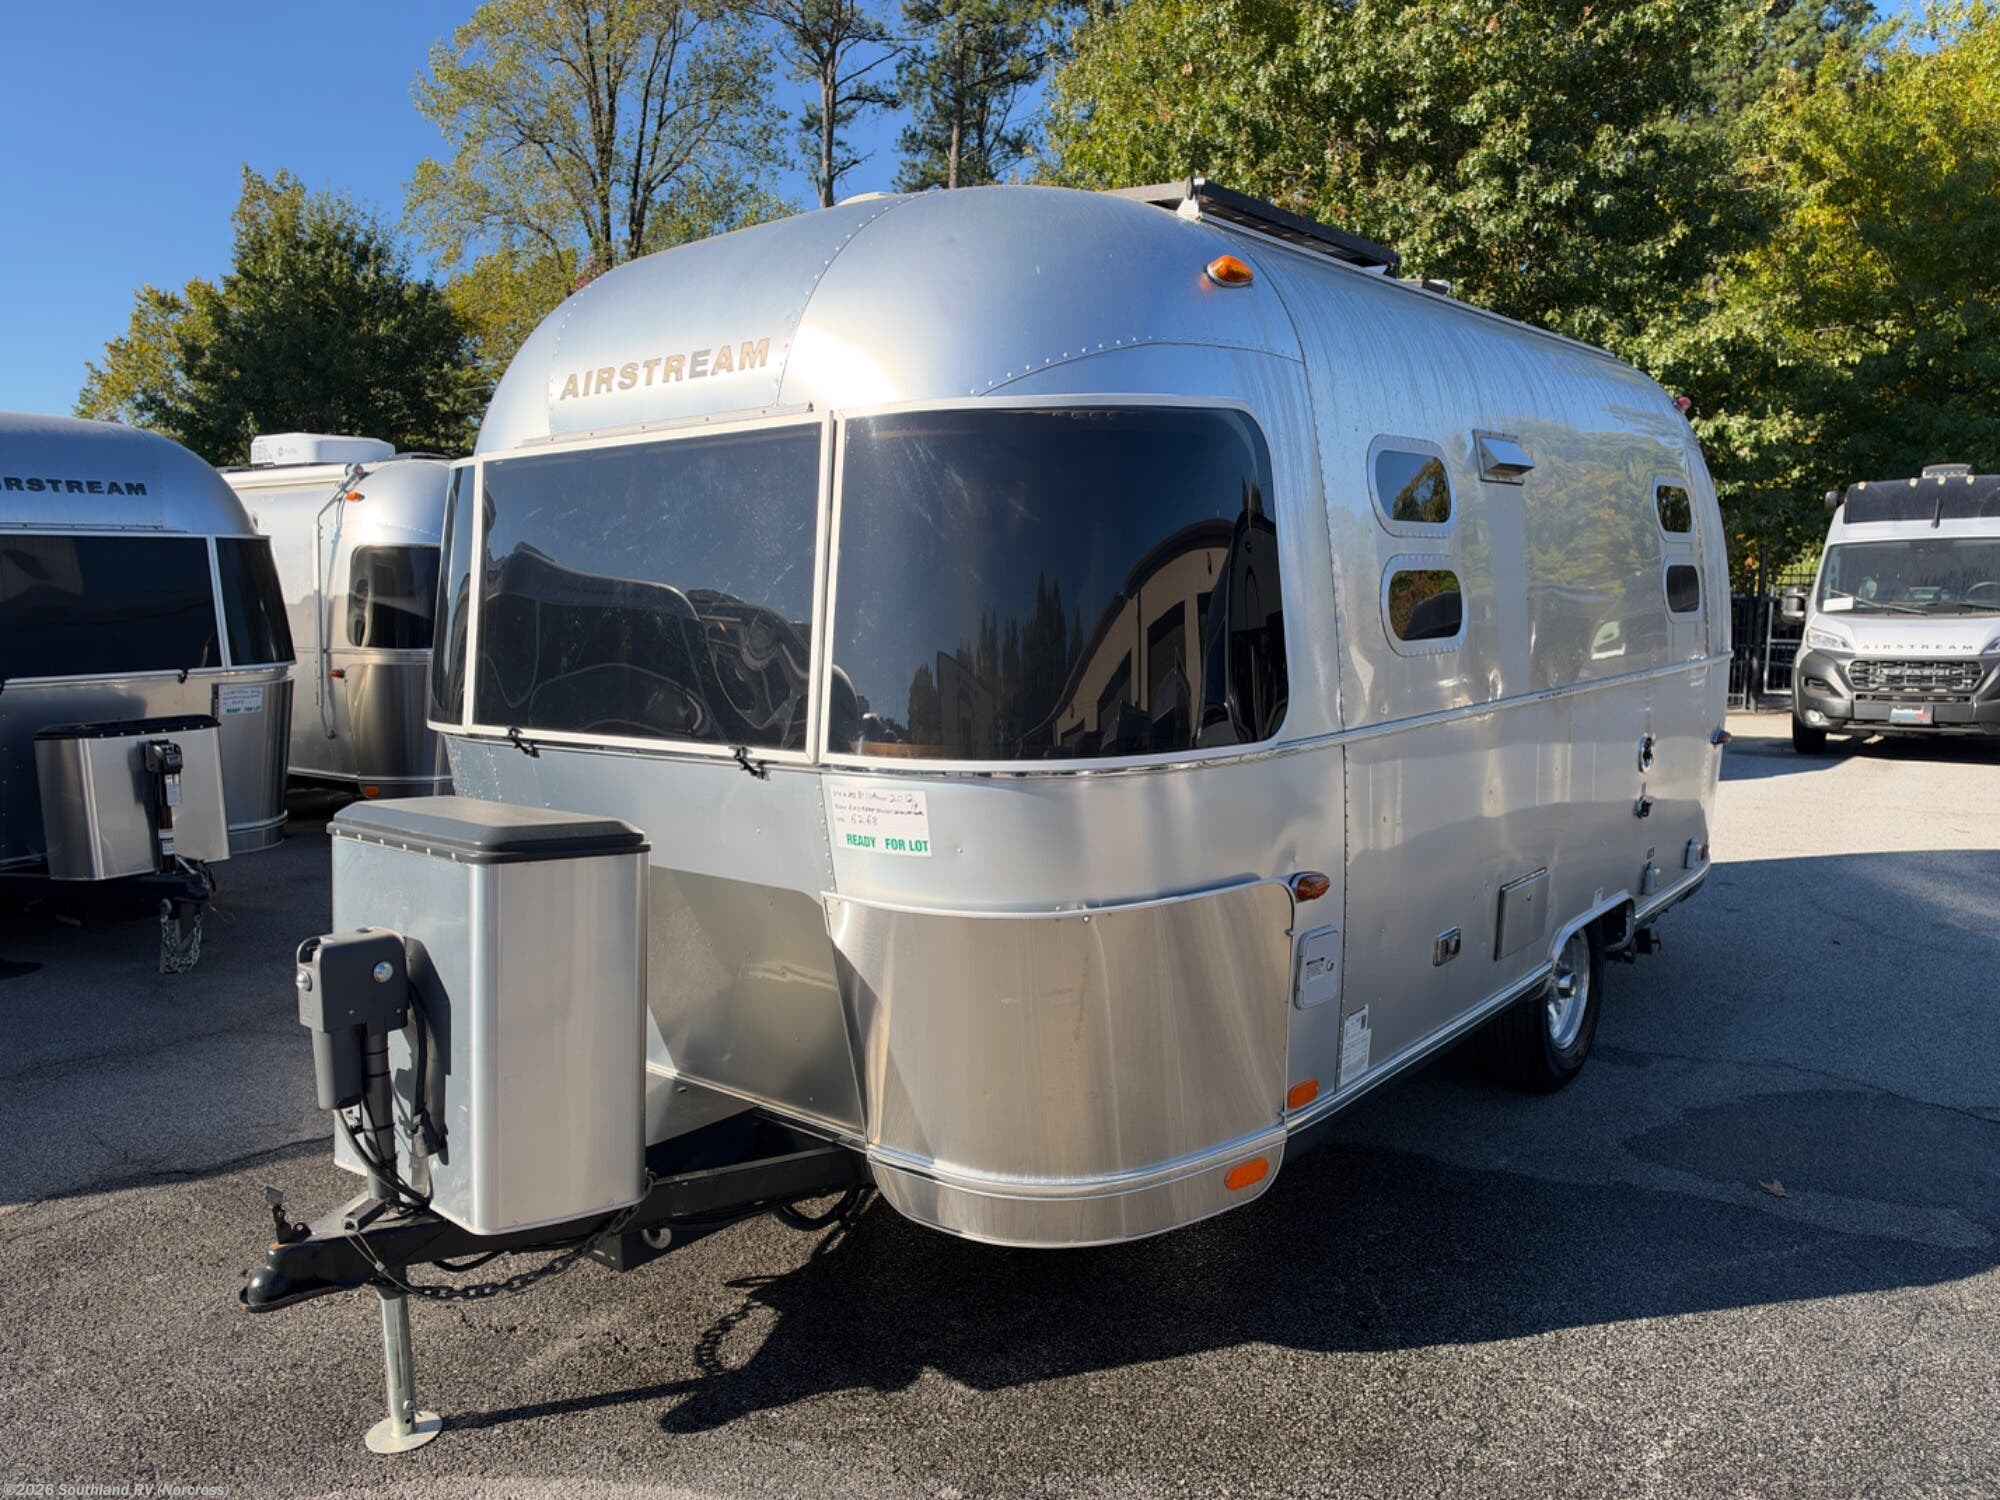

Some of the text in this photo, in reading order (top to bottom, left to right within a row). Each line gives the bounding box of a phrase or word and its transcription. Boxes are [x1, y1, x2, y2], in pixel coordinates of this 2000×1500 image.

[560, 338, 770, 400] AIRSTREAM
[846, 833, 929, 852] READY FOR LOT
